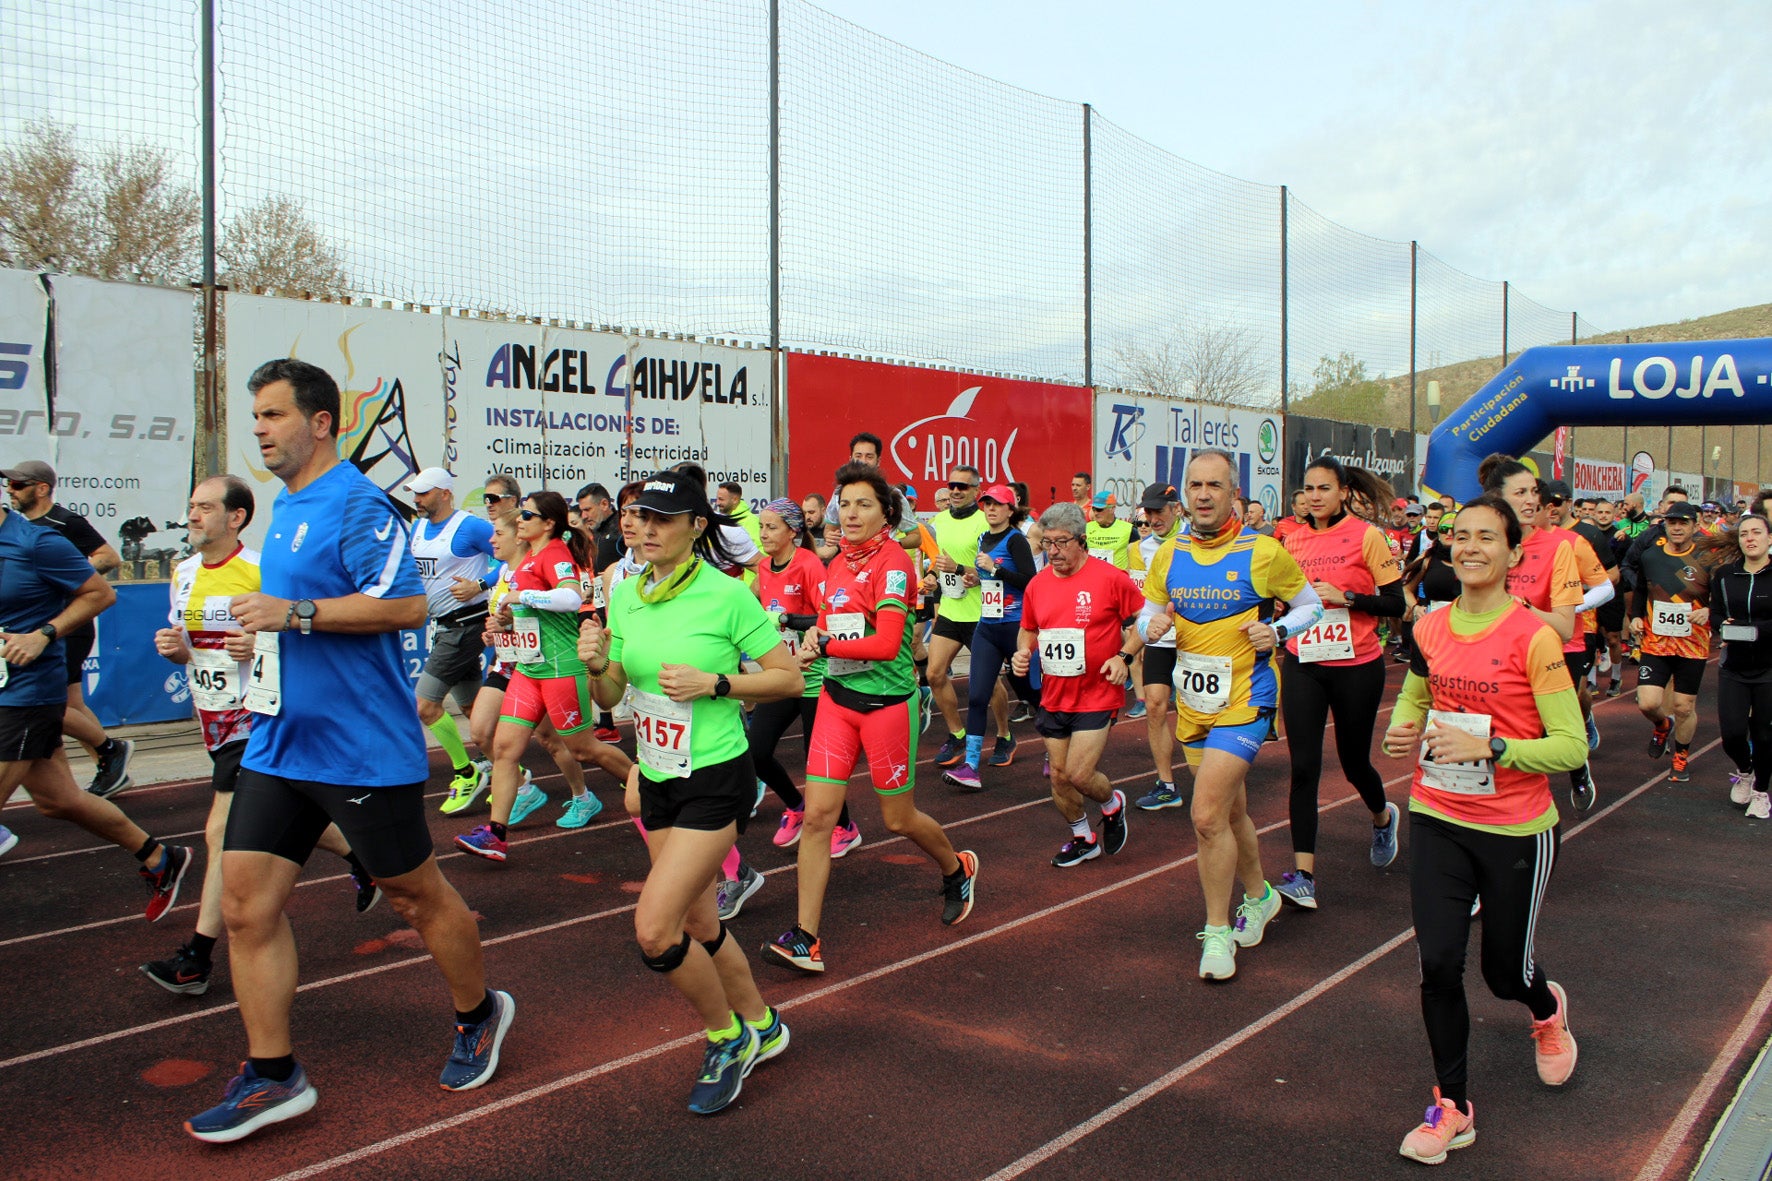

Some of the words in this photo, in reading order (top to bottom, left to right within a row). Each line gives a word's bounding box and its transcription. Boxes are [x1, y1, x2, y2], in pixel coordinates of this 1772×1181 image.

[486, 343, 596, 394] ANGEL
[1608, 353, 1745, 399] LOJA
[1452, 370, 1524, 437] Participación
[1469, 392, 1528, 441] Ciudadana
[109, 415, 185, 441] s.a.
[486, 408, 646, 434] INSTALACIONES
[652, 417, 680, 435] DE:
[1171, 407, 1239, 448] Taleres
[492, 438, 605, 457] Climatización
[925, 434, 998, 483] APOLO
[493, 463, 586, 480] Ventilación
[1258, 466, 1280, 475] ŠKODA
[1574, 462, 1623, 491] BONACHERA
[96, 503, 117, 517] 05
[1171, 585, 1241, 602] agustinos
[1658, 612, 1685, 625] 548
[1301, 623, 1348, 645] 2142
[1044, 643, 1075, 660] 419
[1182, 670, 1219, 694] 708
[633, 711, 686, 750] 2157
